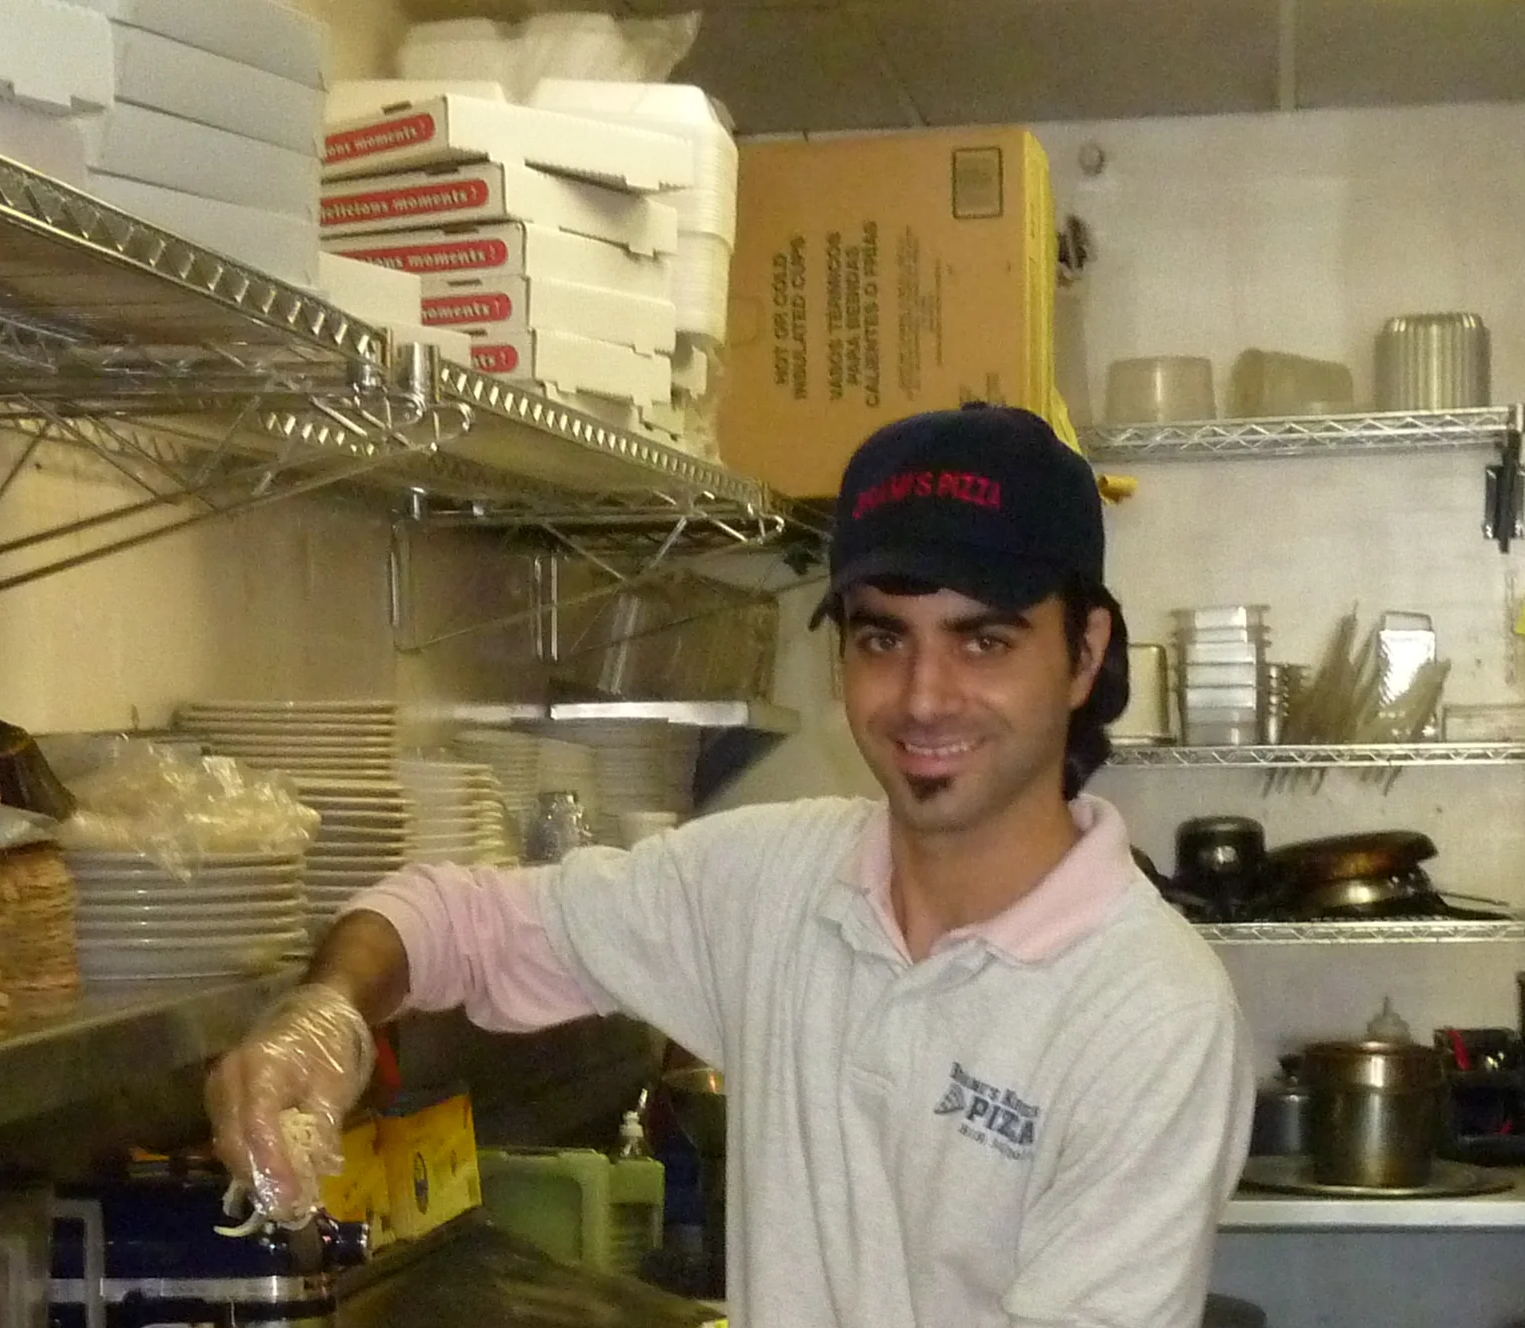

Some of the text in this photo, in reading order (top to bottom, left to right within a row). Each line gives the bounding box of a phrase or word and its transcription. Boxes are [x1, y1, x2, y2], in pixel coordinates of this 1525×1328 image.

[772, 251, 789, 307] COLD
[789, 234, 808, 400] INSULATED CUPS
[773, 345, 789, 384] HOT
[864, 302, 880, 408] CALIENTES
[936, 470, 1001, 511] PIZZA
